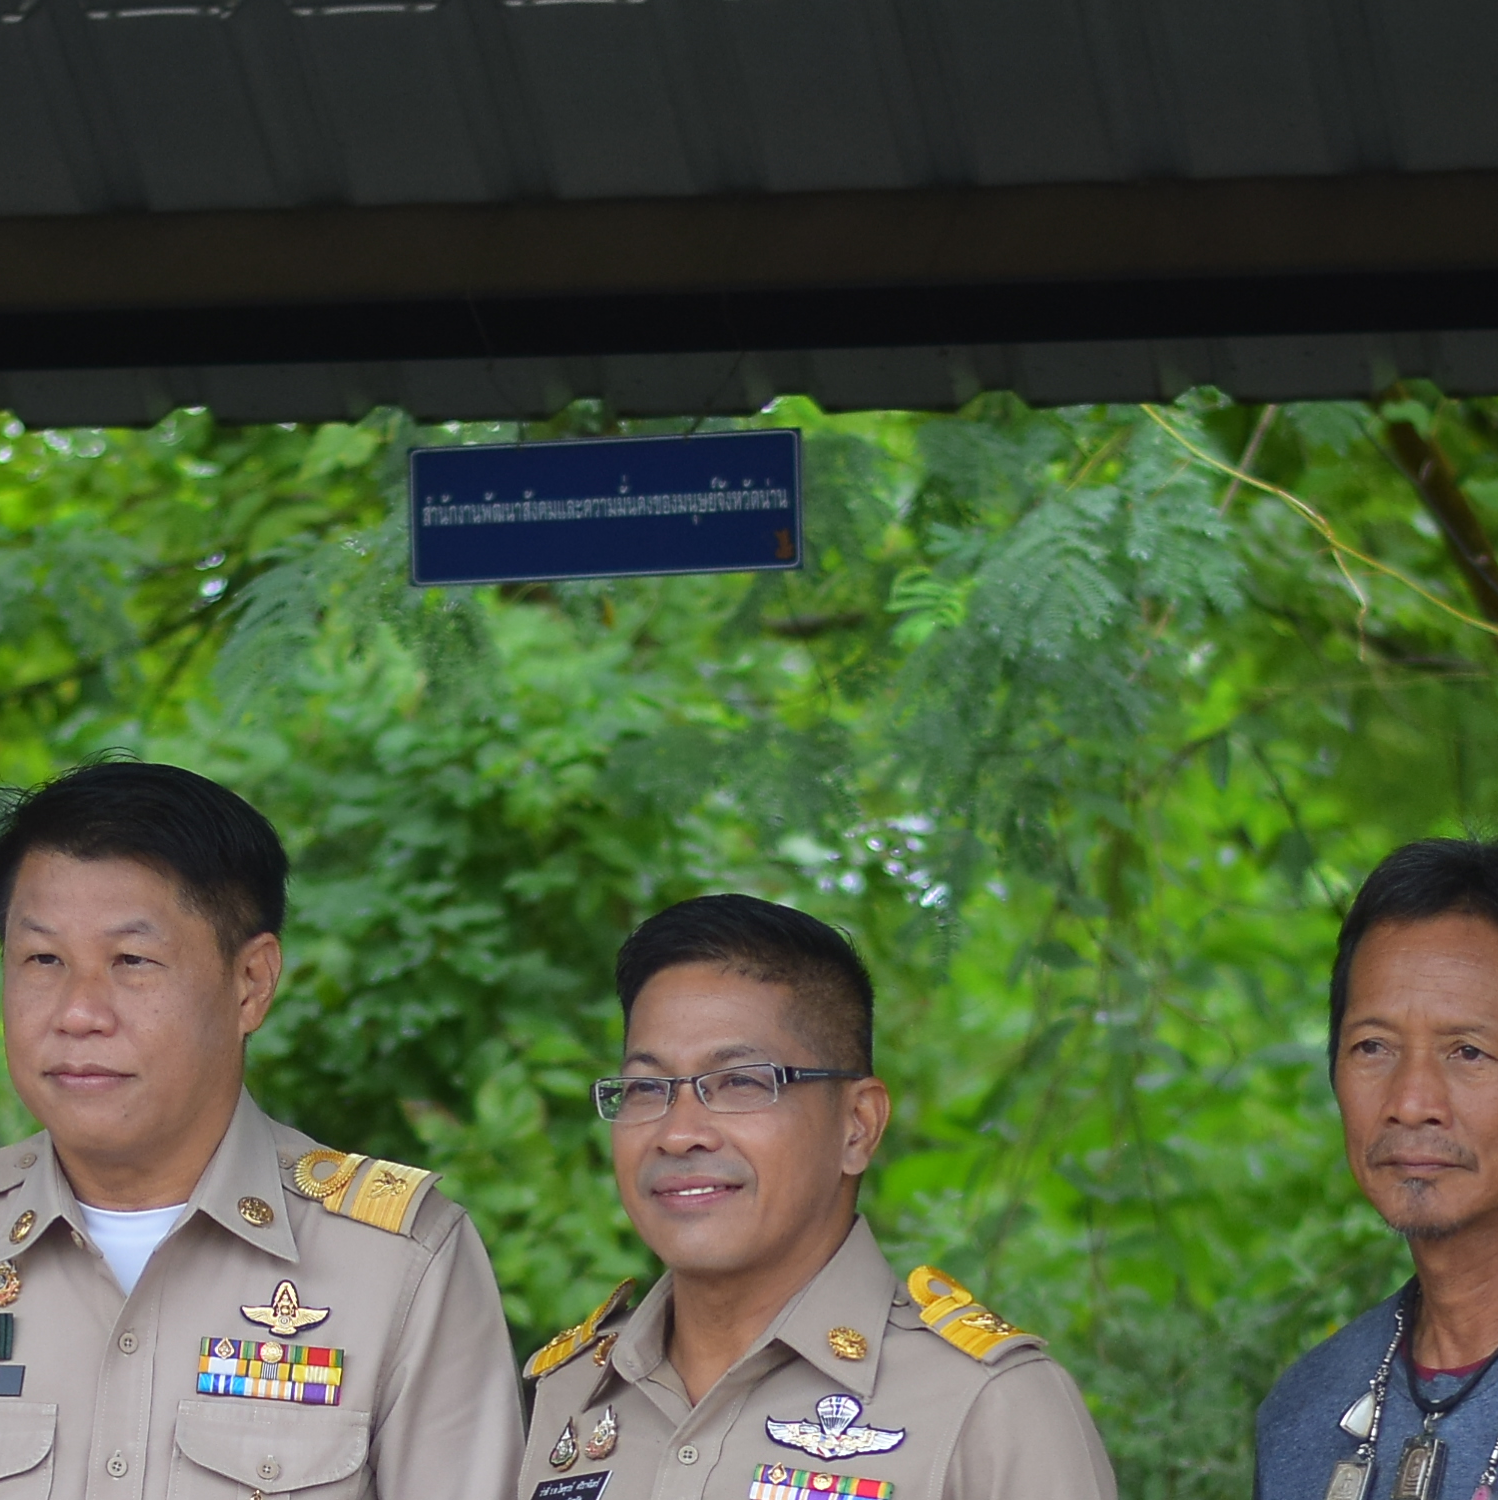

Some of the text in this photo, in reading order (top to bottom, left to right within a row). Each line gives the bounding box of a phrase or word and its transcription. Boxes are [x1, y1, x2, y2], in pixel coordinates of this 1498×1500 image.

[422, 474, 788, 526] สำนักงานพัฒนาสังคมและความมั่นคงของมนุษย์จังหวัดน่าน
